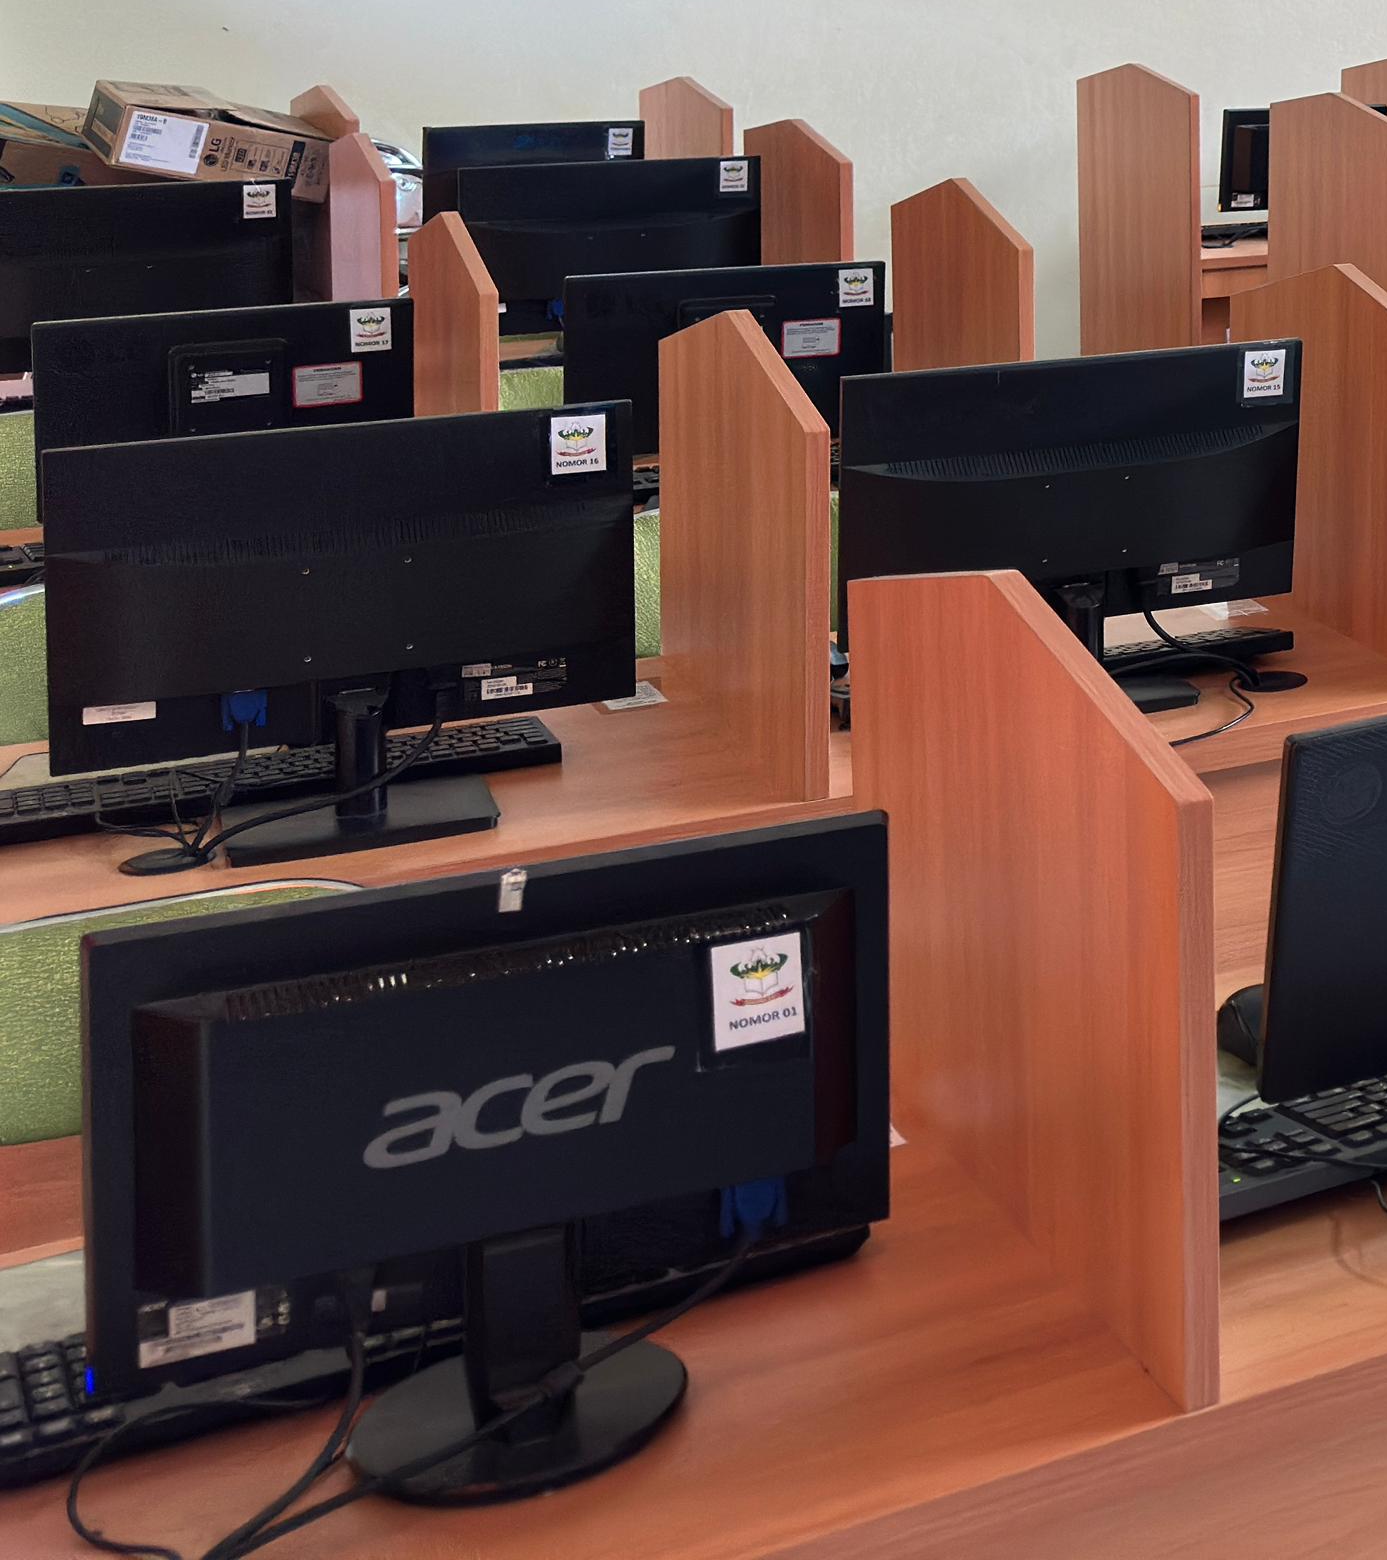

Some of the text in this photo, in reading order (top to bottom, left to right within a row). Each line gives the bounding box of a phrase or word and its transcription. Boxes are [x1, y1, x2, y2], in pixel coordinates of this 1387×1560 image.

[209, 138, 222, 153] LG
[556, 459, 587, 468] NOMOR
[729, 1006, 797, 1030] NOMOR 01
[363, 1045, 676, 1169] acer
